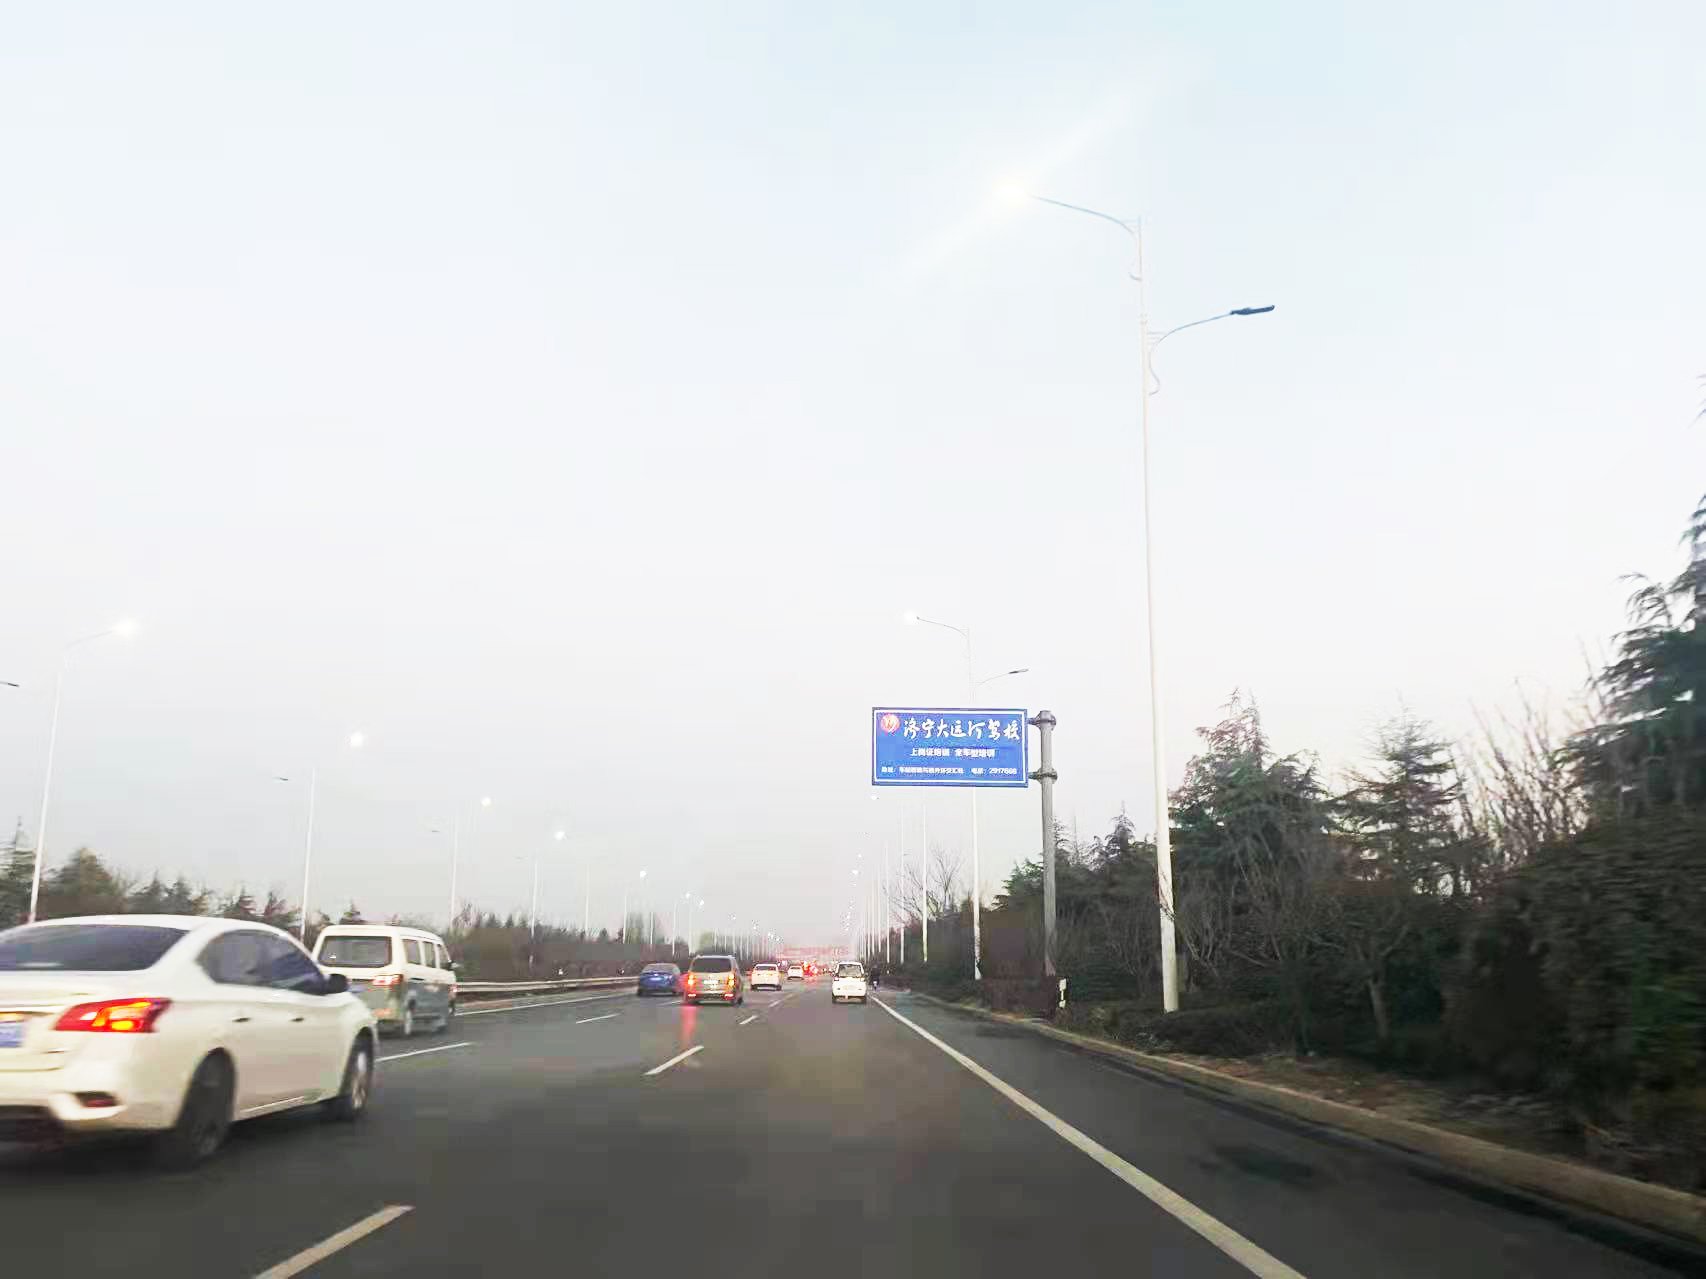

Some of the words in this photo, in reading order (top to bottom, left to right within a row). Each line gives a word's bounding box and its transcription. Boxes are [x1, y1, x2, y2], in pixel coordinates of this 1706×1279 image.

[903, 717, 1020, 740] 济宁大运河驾校
